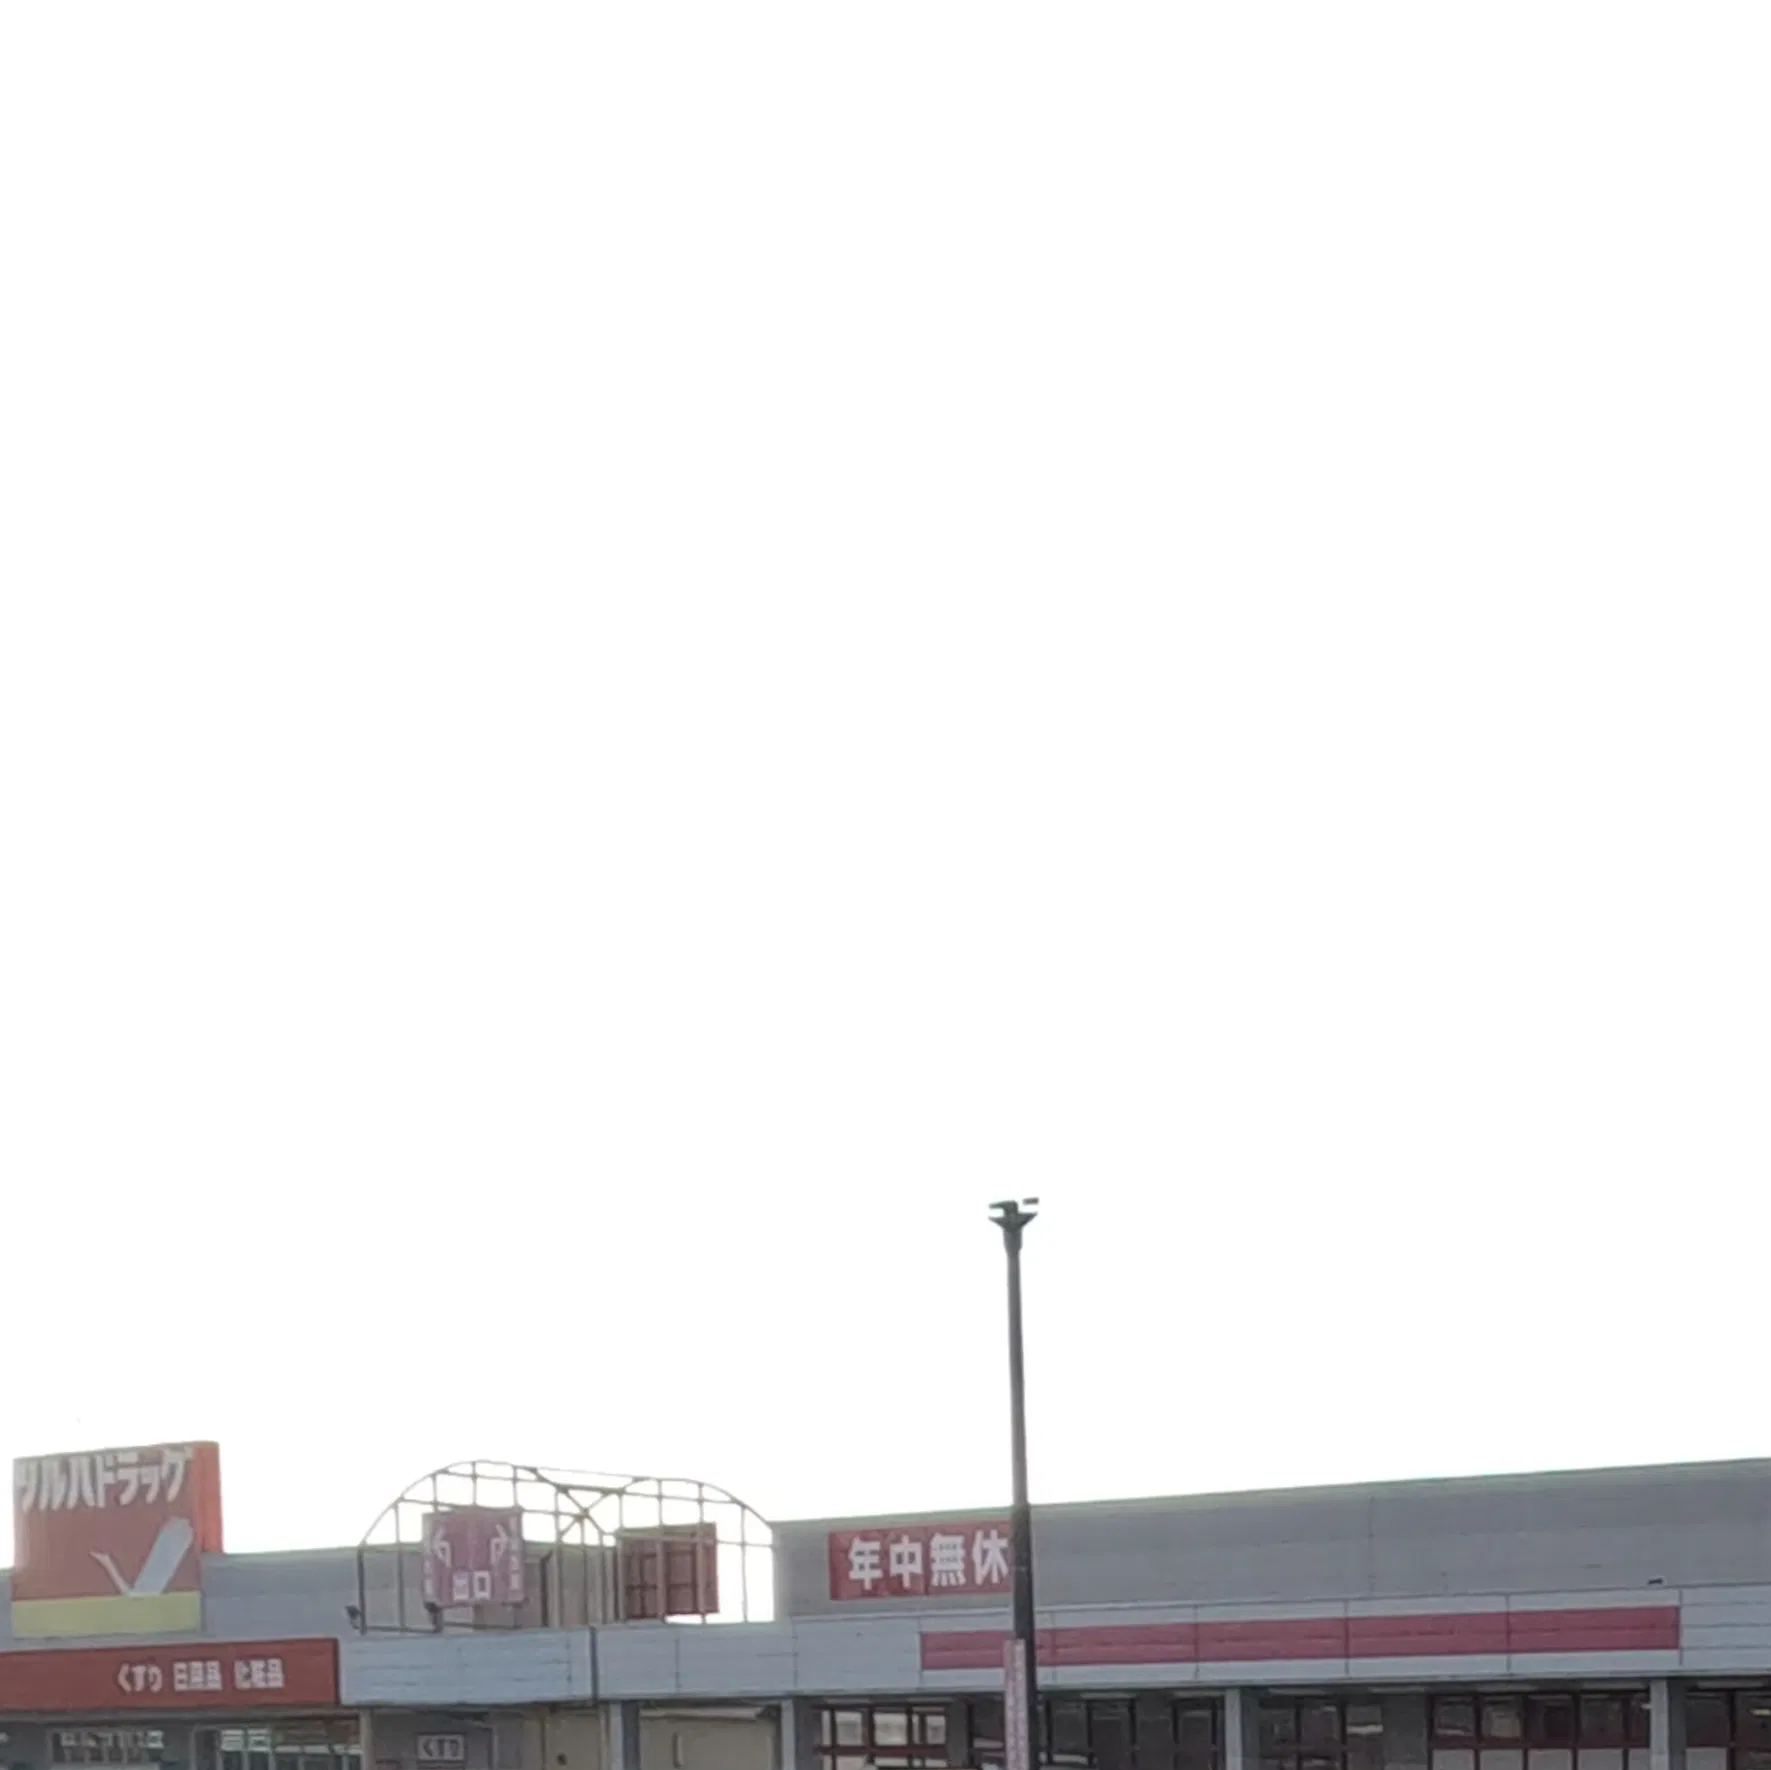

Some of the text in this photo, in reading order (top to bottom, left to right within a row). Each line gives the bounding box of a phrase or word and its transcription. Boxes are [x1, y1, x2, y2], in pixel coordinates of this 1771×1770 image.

[14, 1445, 194, 1513] ツルハドラッグ
[848, 1529, 1009, 1590] 年中無休
[118, 1663, 163, 1692] くすり
